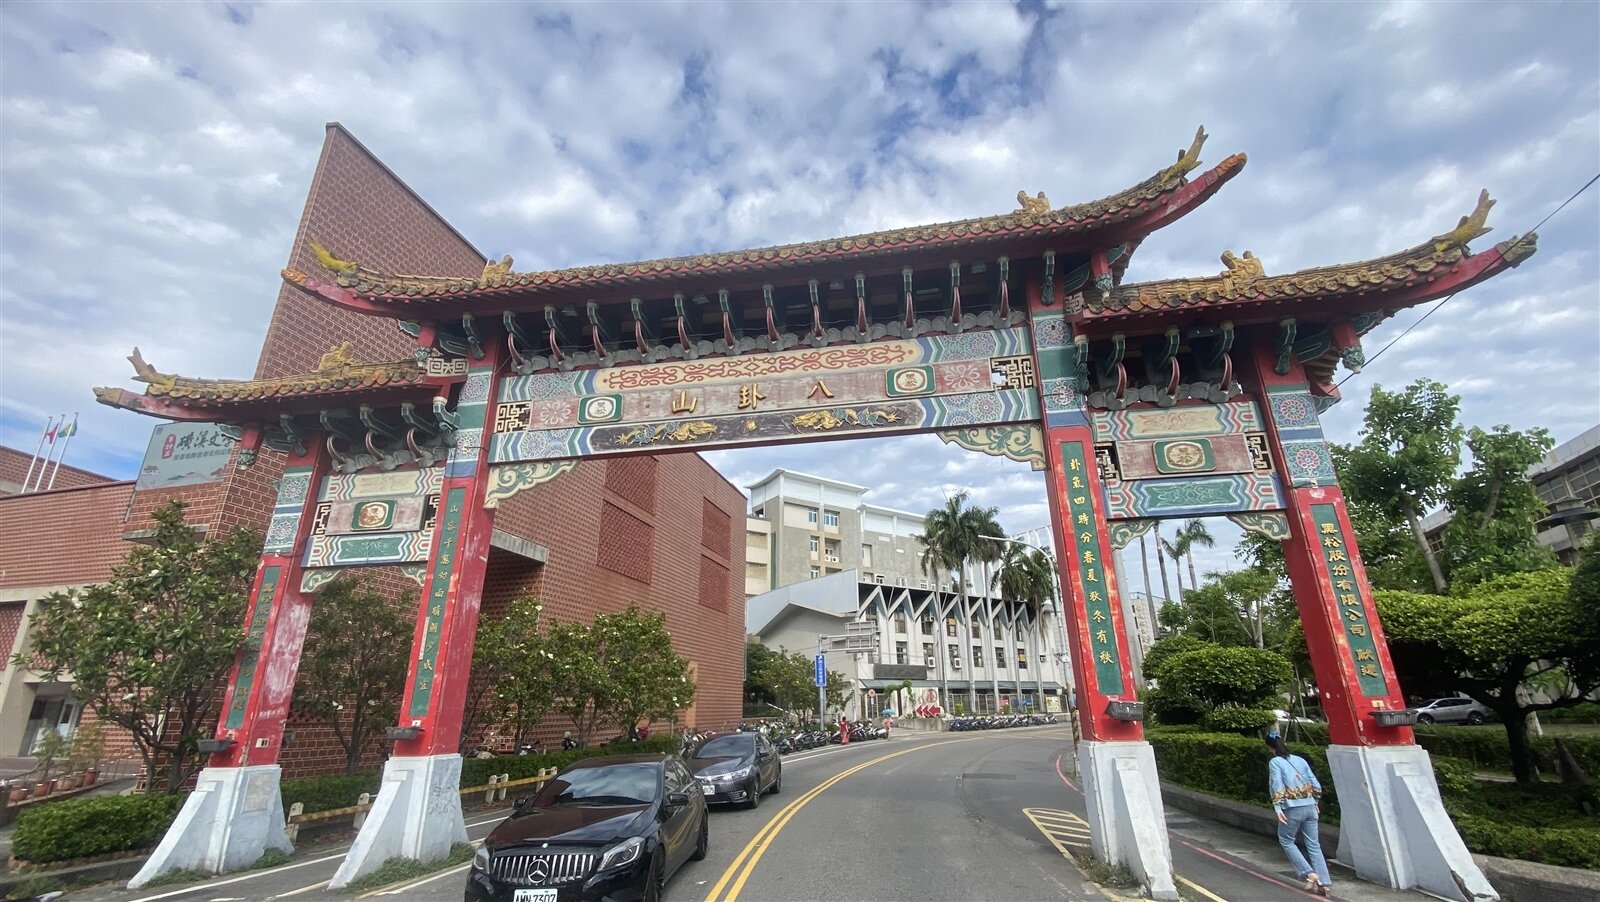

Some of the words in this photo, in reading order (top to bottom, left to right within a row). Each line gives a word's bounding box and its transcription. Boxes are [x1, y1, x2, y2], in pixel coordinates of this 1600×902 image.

[1321, 523, 1366, 637] 黑松股份有限公司
